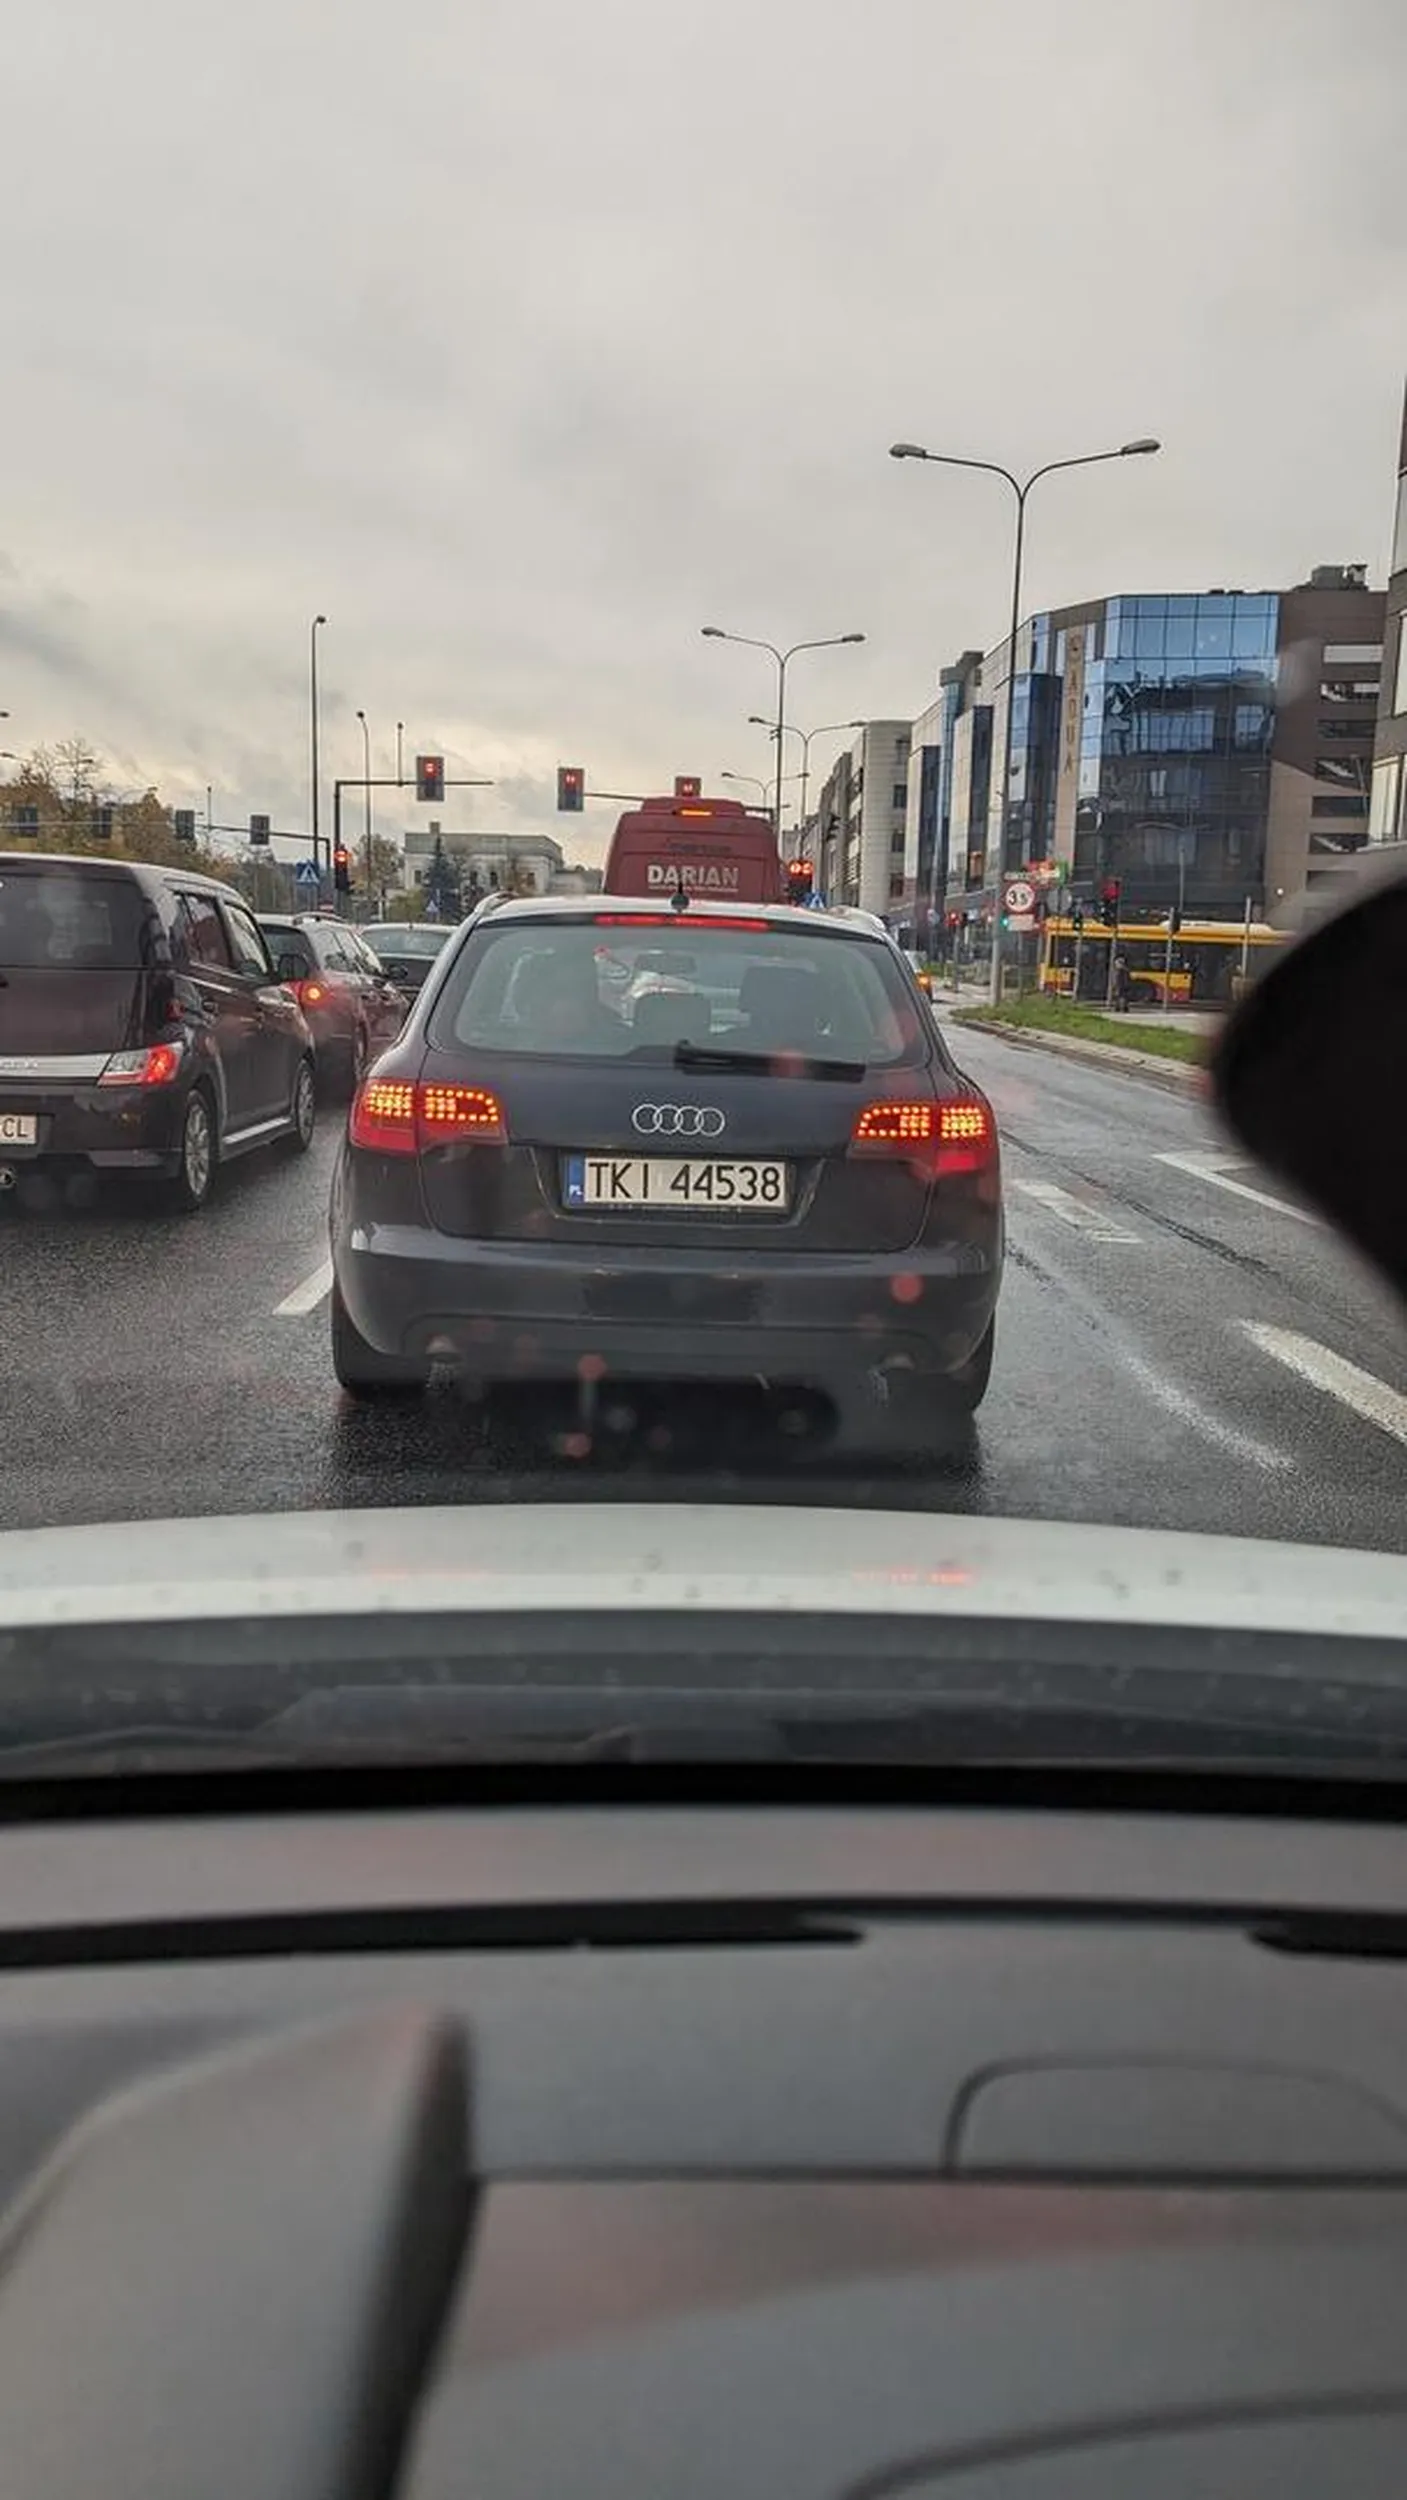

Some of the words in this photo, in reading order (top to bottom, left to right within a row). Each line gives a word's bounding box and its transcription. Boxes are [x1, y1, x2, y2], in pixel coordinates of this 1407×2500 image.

[647, 864, 739, 887] DARIAN
[588, 1162, 649, 1199] TKI
[670, 1164, 781, 1201] 44538
